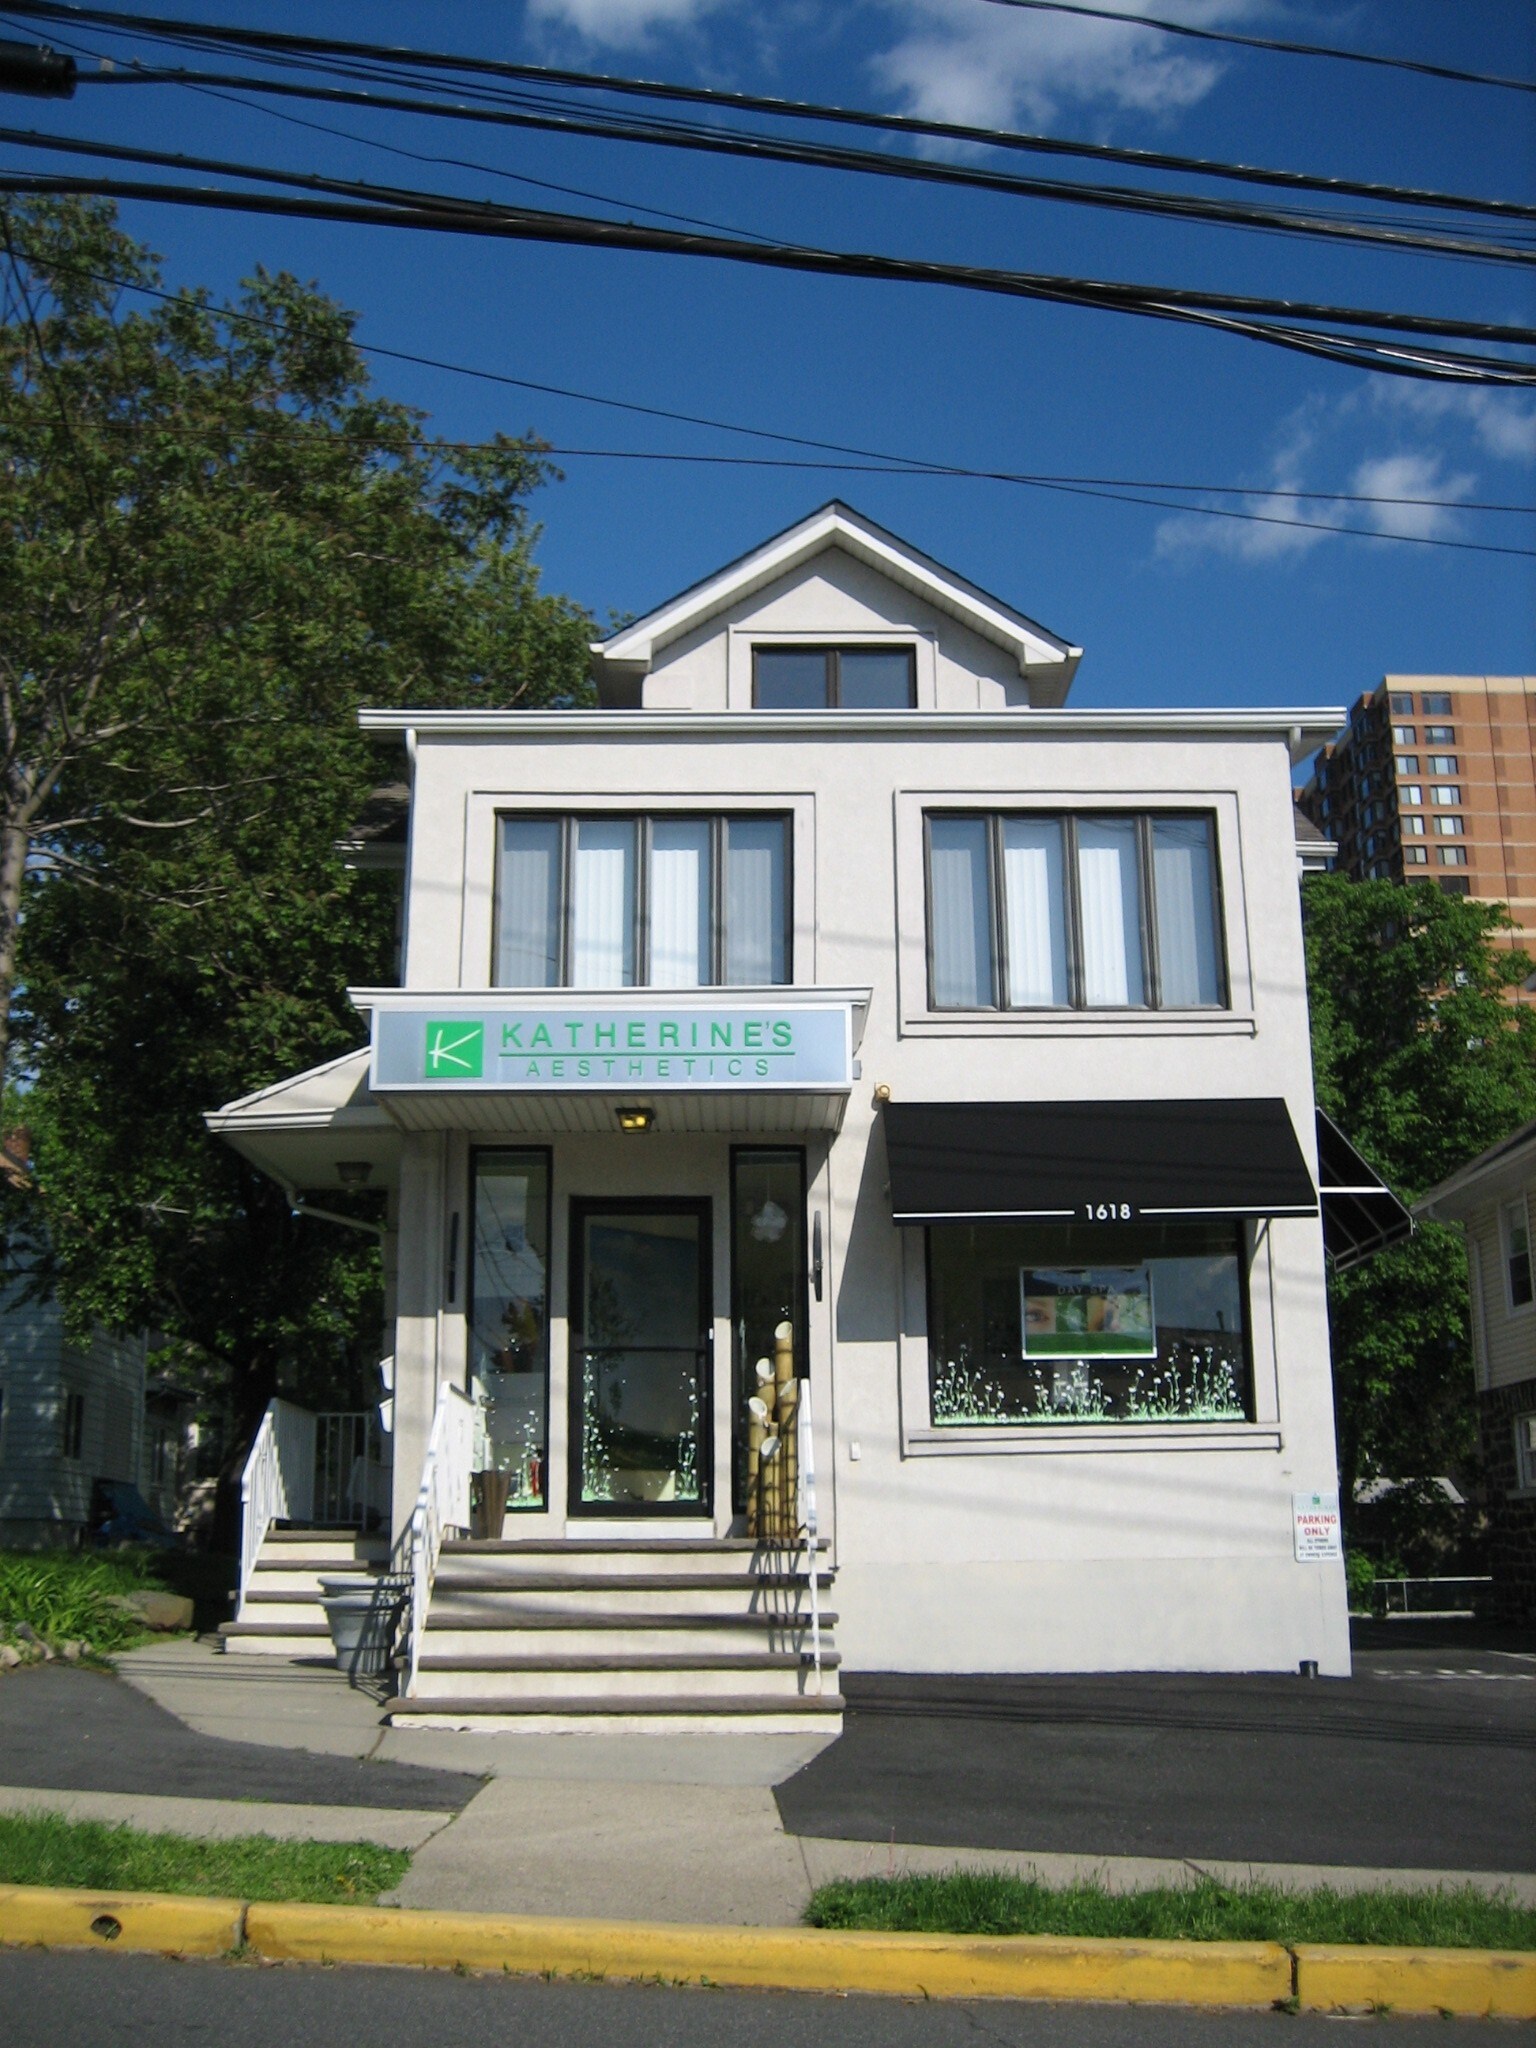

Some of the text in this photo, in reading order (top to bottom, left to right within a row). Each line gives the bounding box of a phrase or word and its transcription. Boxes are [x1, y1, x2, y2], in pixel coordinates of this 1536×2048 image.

[502, 1021, 792, 1048] KATHERINE'S
[428, 1029, 482, 1069] K
[526, 1058, 770, 1077] AESTHETICS
[1085, 1203, 1132, 1220] 1618
[1058, 1284, 1116, 1294] DAY SPA
[1297, 1515, 1337, 1524] PARKING
[1304, 1527, 1330, 1535] ONLY
